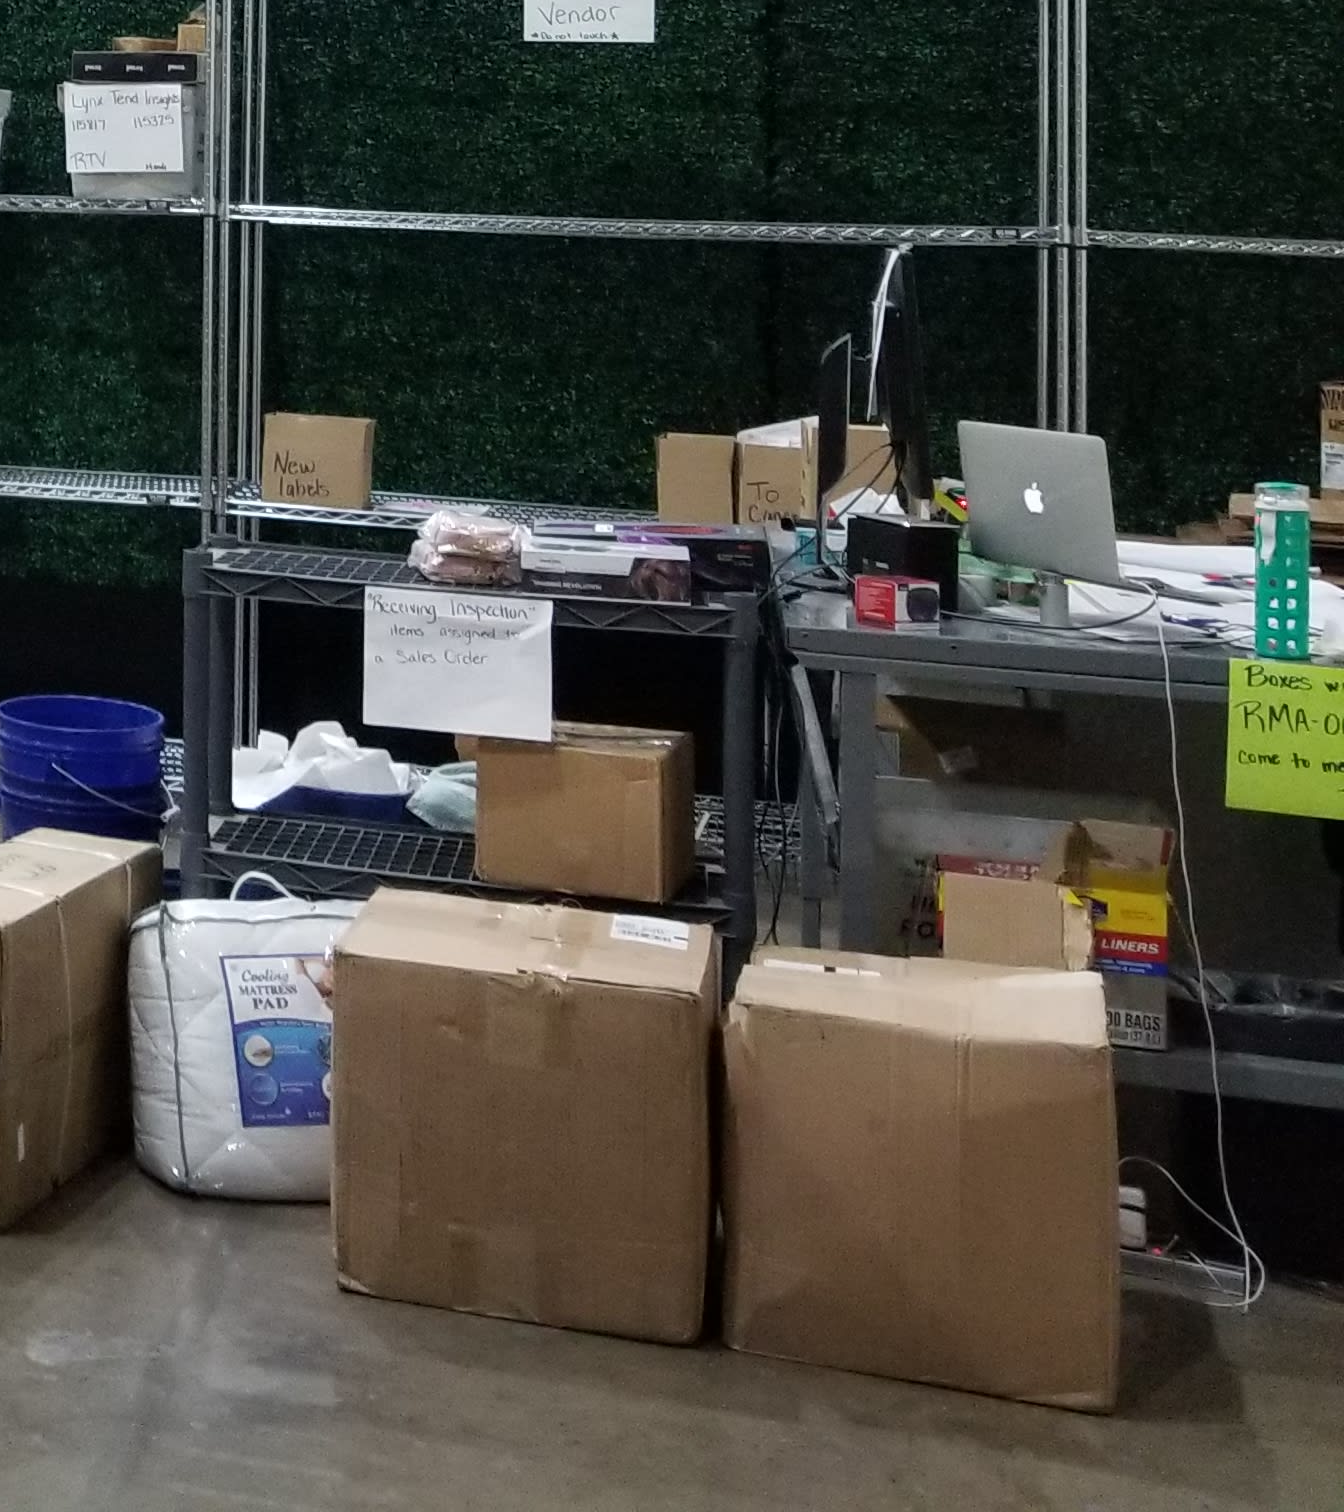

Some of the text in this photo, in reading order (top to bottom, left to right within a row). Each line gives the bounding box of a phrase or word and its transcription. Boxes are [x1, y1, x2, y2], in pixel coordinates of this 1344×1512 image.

[538, 2, 622, 25] Vendor
[72, 93, 103, 113] Lynx
[109, 90, 139, 105] Tend
[70, 151, 106, 170] RTV
[273, 450, 316, 475] New
[279, 478, 330, 498] labels
[746, 481, 780, 503] To
[389, 624, 424, 637] items
[439, 626, 497, 644] assigned
[374, 648, 488, 666] a Sales Order
[1244, 664, 1313, 691] Boxes
[1238, 750, 1281, 766] come
[1291, 752, 1311, 769] to
[1101, 938, 1160, 955] LINERS
[242, 969, 289, 983] Cooling
[239, 985, 298, 996] MATTRESS
[252, 997, 289, 1010] PAD
[1125, 1012, 1161, 1032] BAGS
